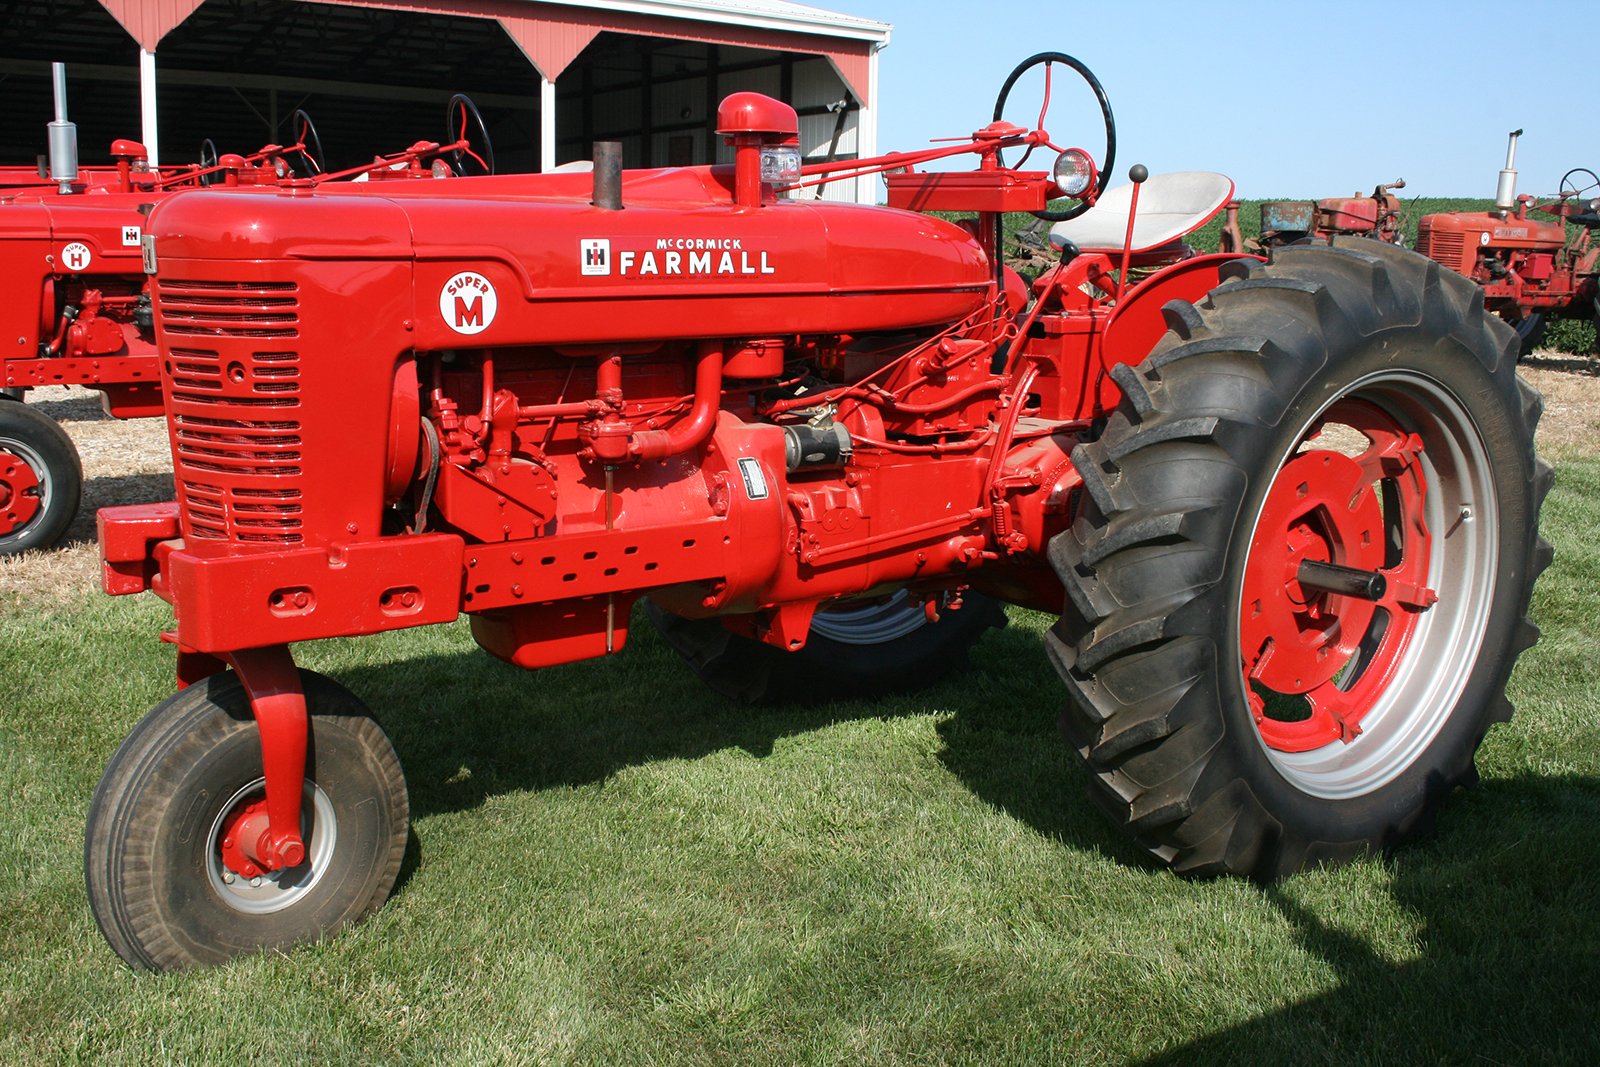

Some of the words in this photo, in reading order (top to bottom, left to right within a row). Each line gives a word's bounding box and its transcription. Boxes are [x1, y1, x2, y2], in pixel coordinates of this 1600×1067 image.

[66, 244, 87, 253] SUPER
[71, 254, 82, 267] H
[620, 251, 775, 276] FARMALL
[447, 276, 489, 296] SUPER
[454, 296, 484, 327] M
